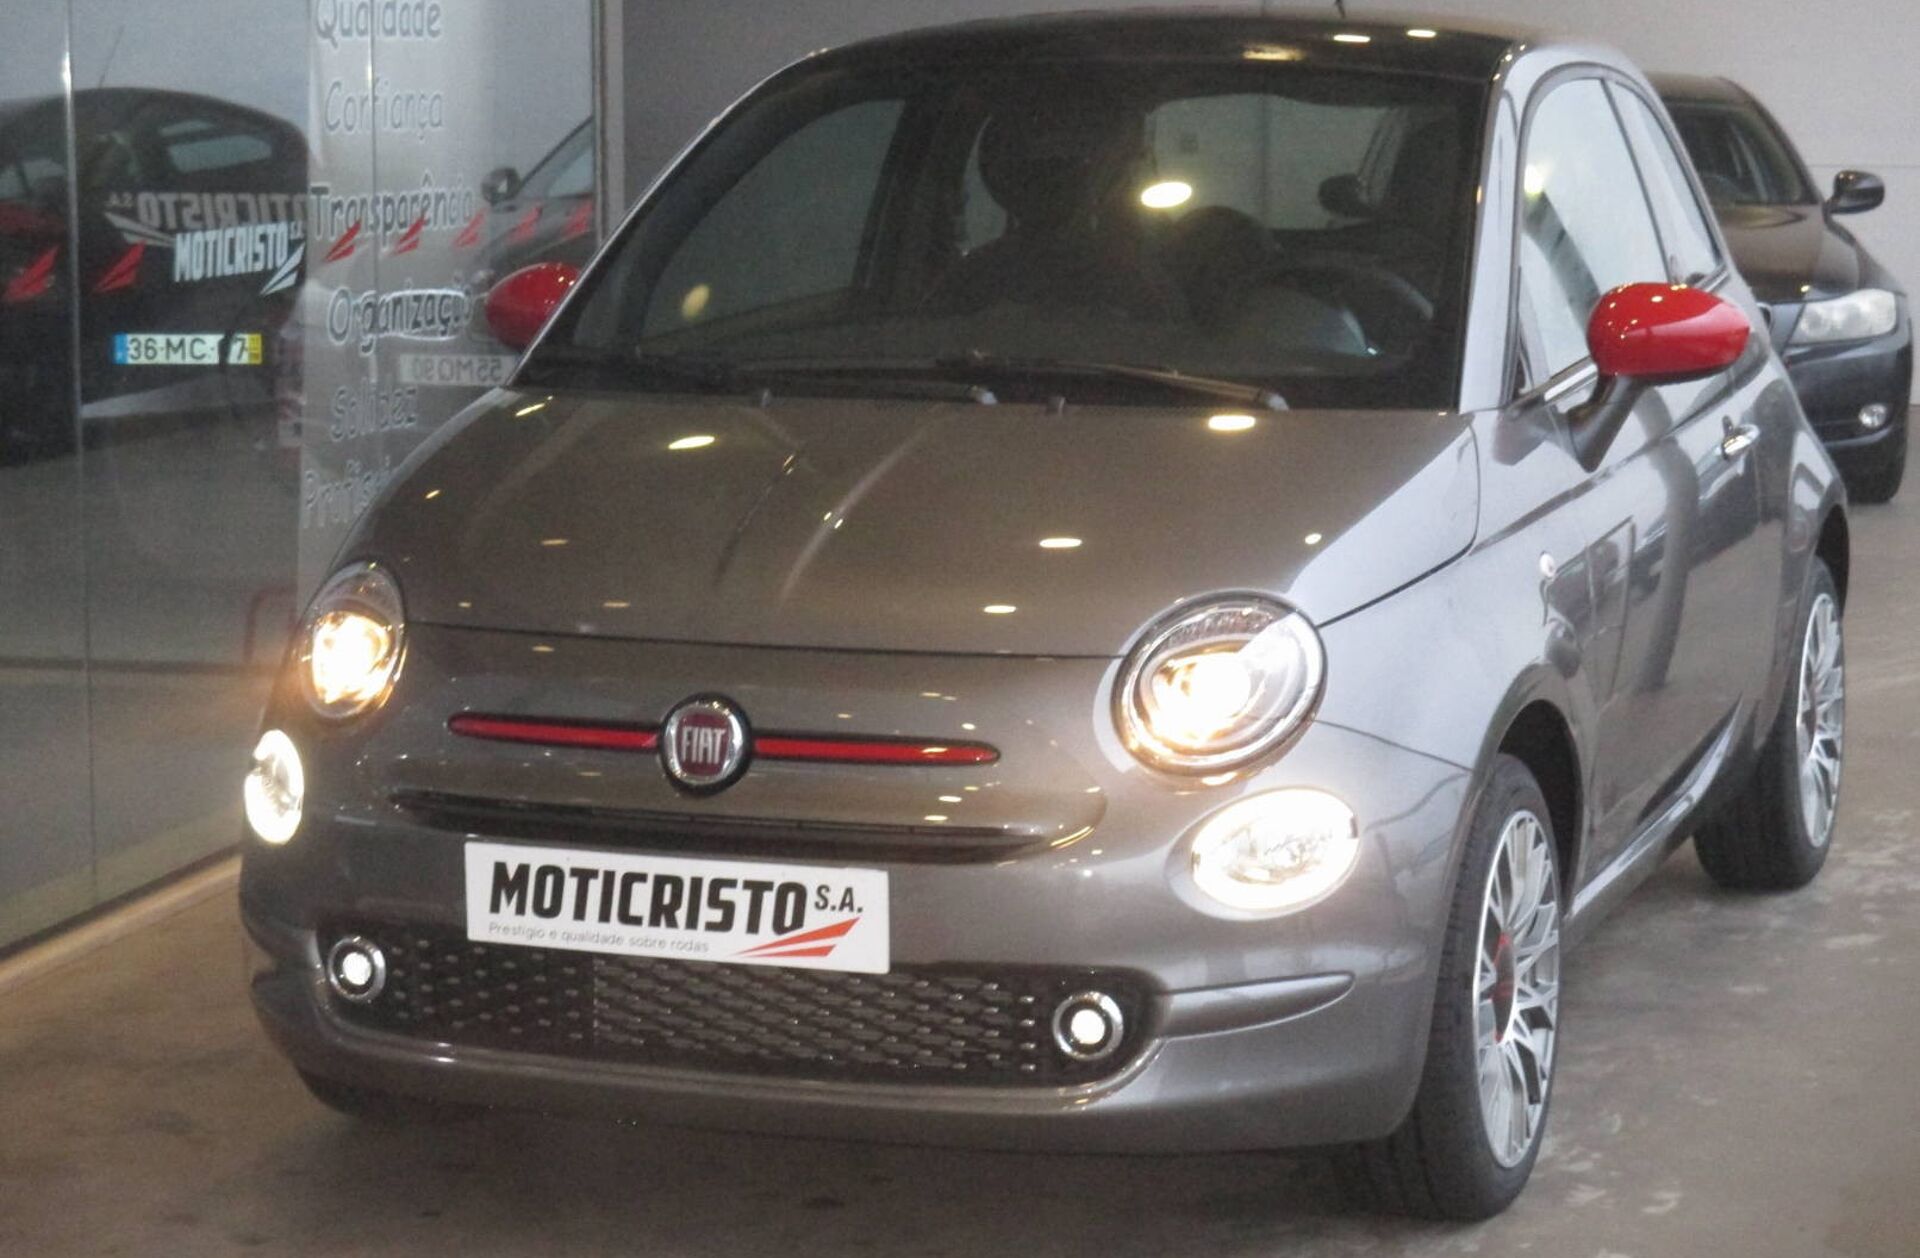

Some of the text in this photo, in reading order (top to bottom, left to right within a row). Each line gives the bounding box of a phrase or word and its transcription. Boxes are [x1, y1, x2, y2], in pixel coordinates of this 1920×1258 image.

[174, 221, 289, 283] MOTICRISTO
[129, 337, 247, 361] 36-MC-7
[680, 725, 728, 765] FIAT
[489, 861, 864, 936] MOTICRISTO S.A.
[548, 928, 558, 940] e
[561, 927, 624, 945] qualidade
[628, 933, 666, 949] sobre
[670, 937, 710, 953] rodas
